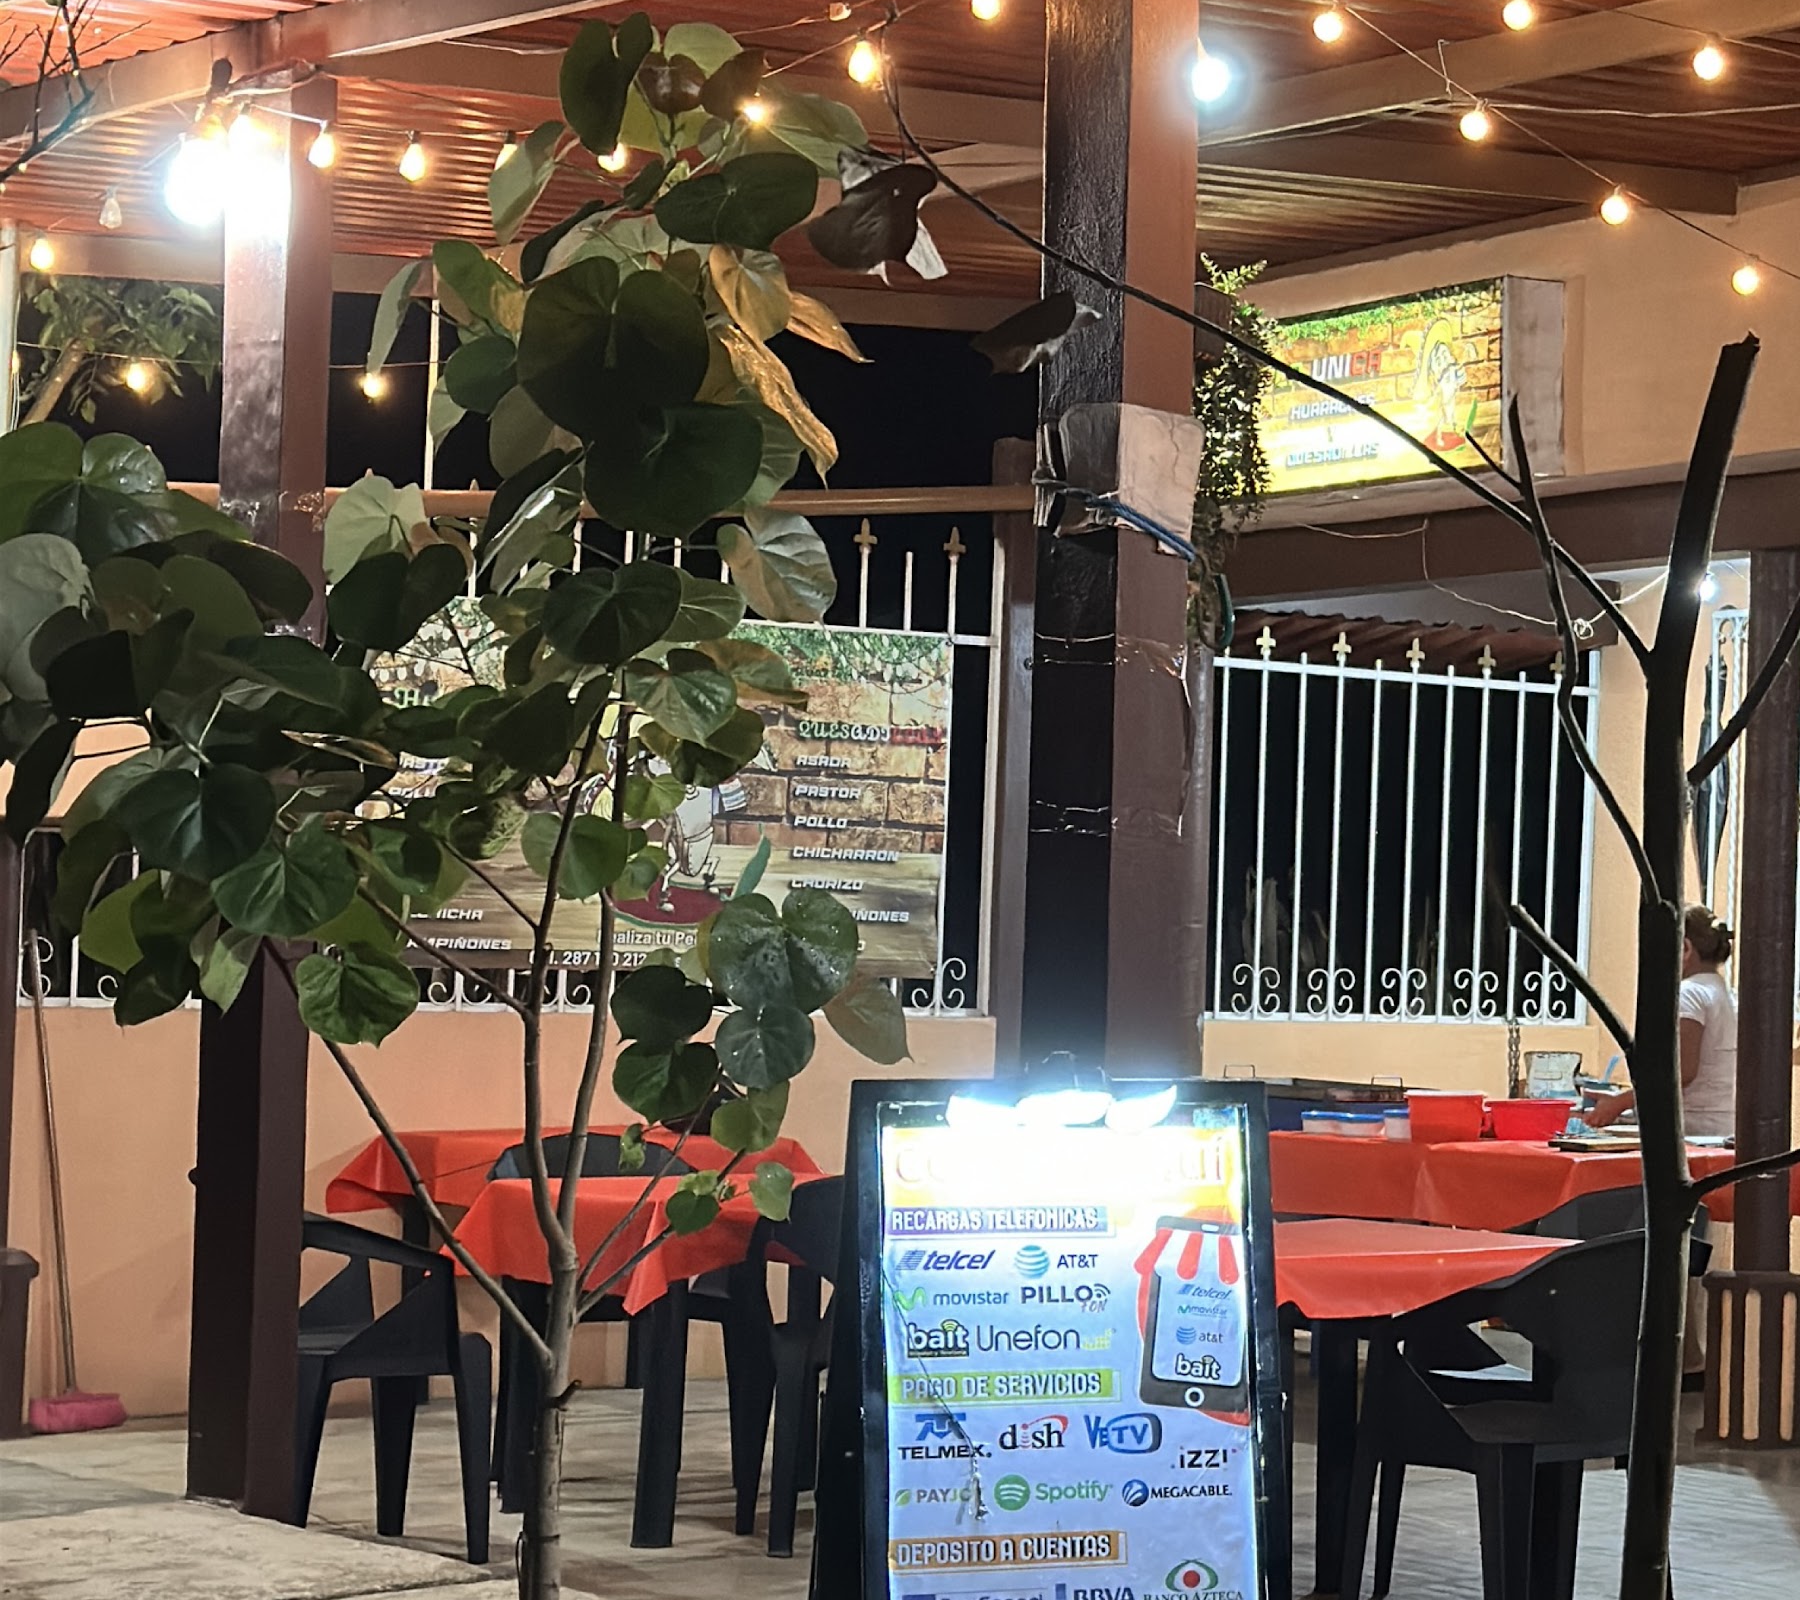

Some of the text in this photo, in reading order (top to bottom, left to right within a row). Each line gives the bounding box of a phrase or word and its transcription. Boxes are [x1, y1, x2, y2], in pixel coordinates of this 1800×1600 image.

[797, 755, 851, 768] ASADA
[795, 785, 861, 799] PASTOR
[794, 815, 848, 829] POLLO
[792, 845, 899, 862] CHICHARRON
[656, 931, 671, 945] tu
[563, 951, 591, 966] 287
[892, 1208, 1099, 1231] RECARGAS TELEFONICAS
[922, 1249, 996, 1271] telcel
[1057, 1254, 1098, 1269] AT&T
[933, 1290, 1009, 1305] movistar
[1021, 1285, 1093, 1304] PILLO
[1191, 1286, 1232, 1300] telcel
[908, 1320, 969, 1351] bait
[976, 1323, 1081, 1352] Unefon
[1198, 1331, 1224, 1344] at&t
[1175, 1352, 1221, 1380] bait
[902, 1373, 1101, 1399] PAGO DE SERVICIOS
[1000, 1420, 1067, 1449] dish
[1035, 1481, 1110, 1502] Spotify
[898, 1535, 1111, 1566] DEPOSITO A CUENTAS
